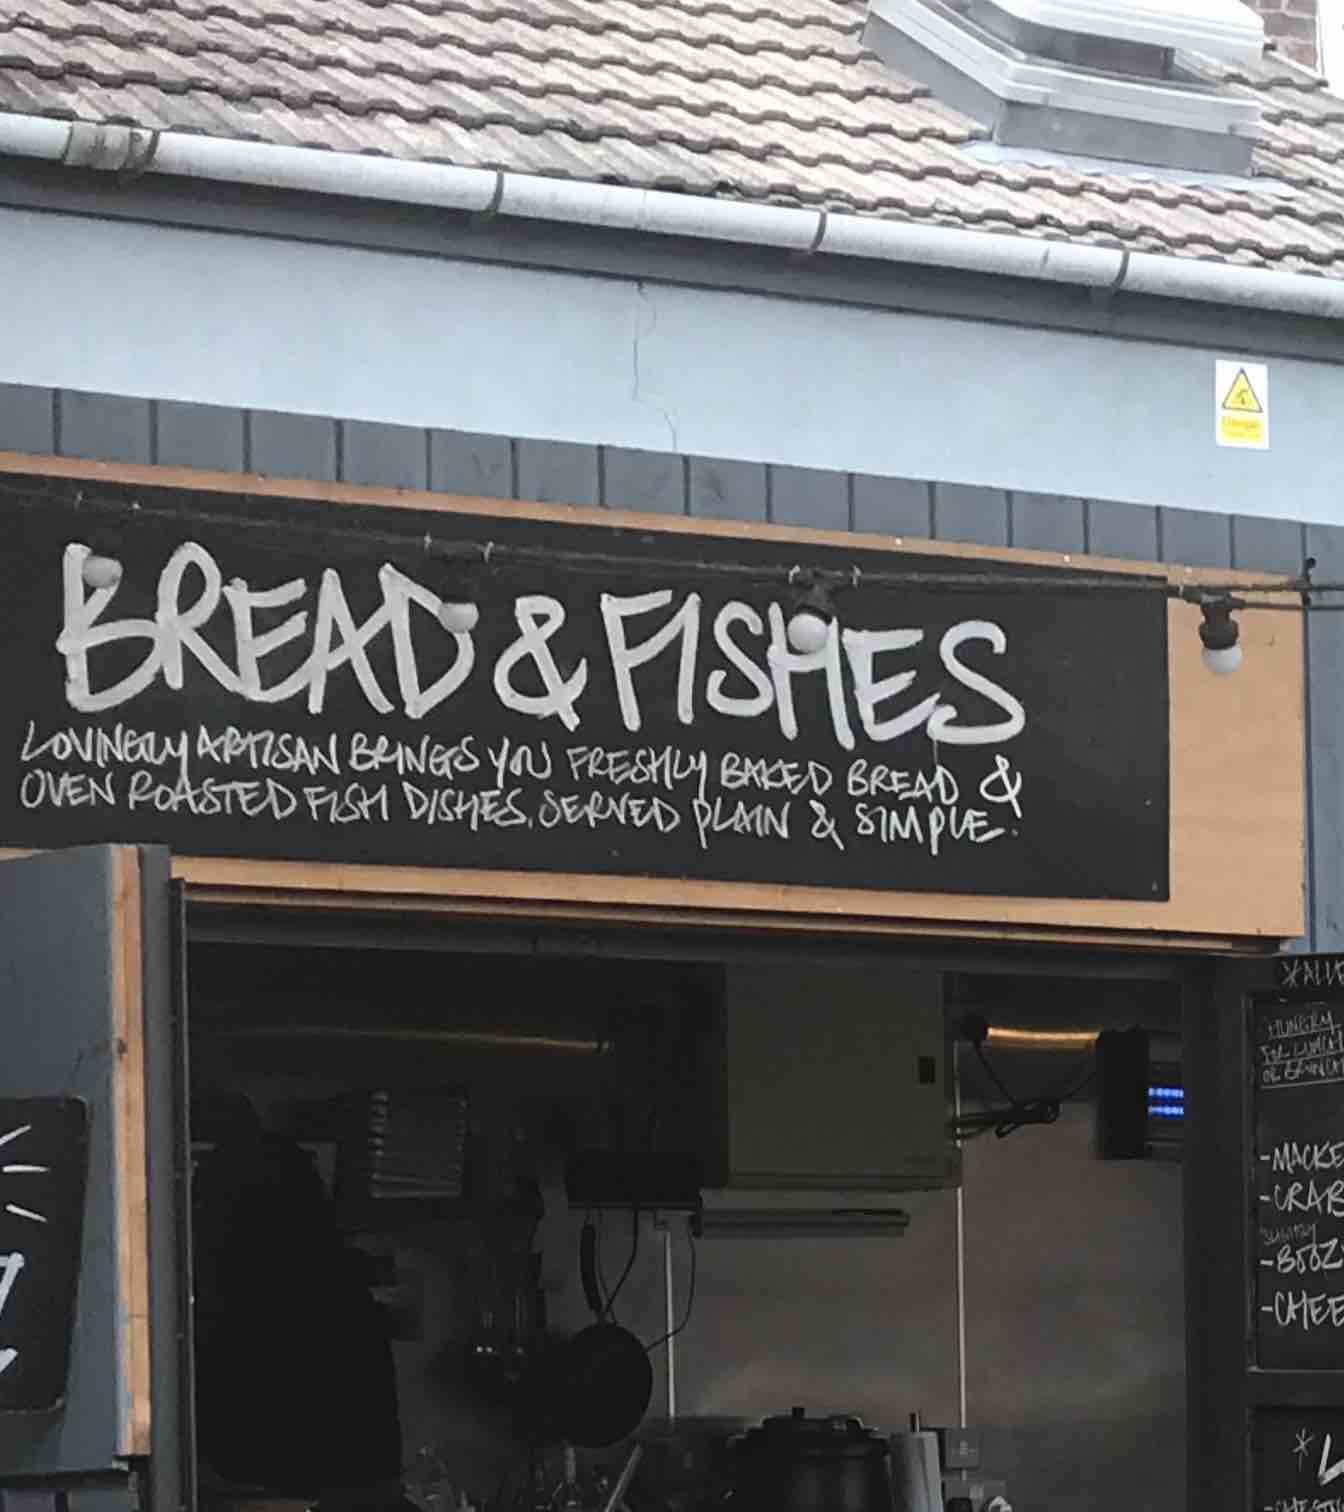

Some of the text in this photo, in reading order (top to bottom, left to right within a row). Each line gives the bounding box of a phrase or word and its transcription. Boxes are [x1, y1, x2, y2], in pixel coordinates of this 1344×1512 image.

[57, 542, 1025, 750] BREAD & FISHES
[20, 771, 115, 808] OVEN
[128, 770, 299, 821] ROASTED
[306, 785, 390, 823] FISH
[538, 789, 680, 834] SERVED
[692, 797, 789, 850] PLAIN
[810, 803, 845, 850] &
[21, 722, 1022, 819] LOVINGLY ARTISAN BRINGS YOU FRESHLY BAKED BREAD &
